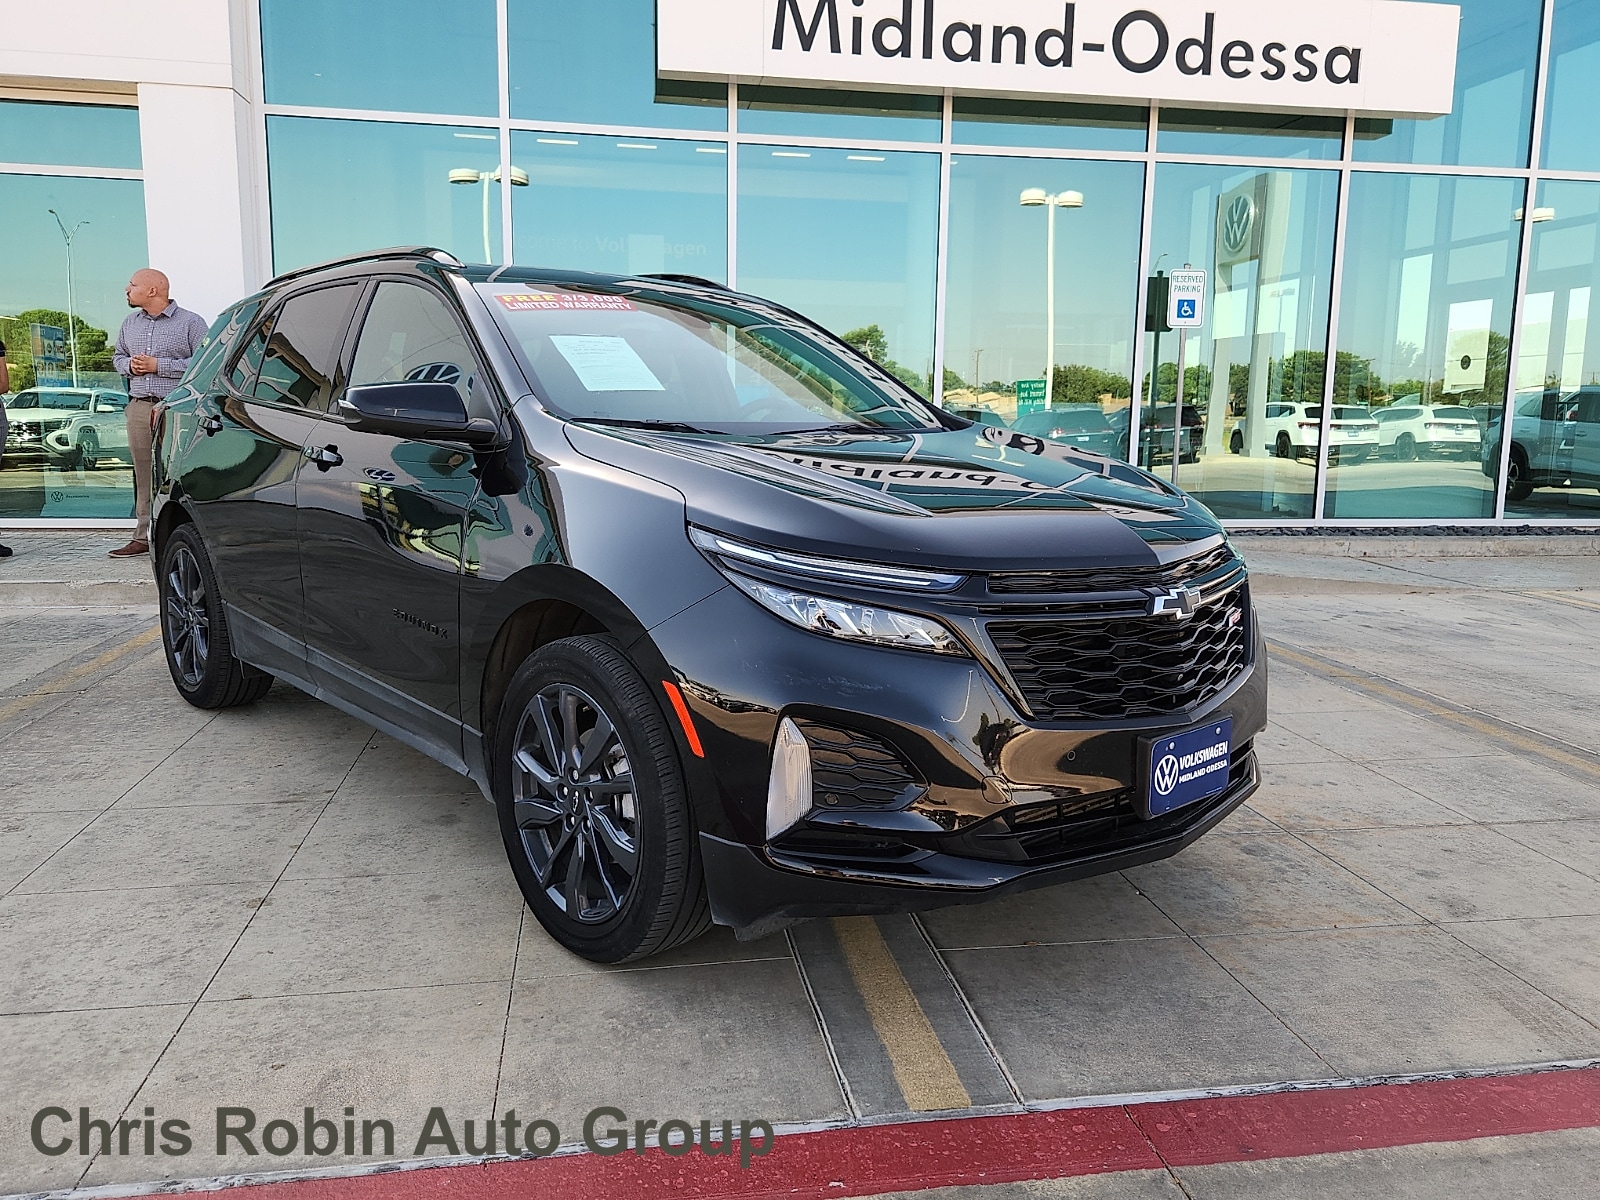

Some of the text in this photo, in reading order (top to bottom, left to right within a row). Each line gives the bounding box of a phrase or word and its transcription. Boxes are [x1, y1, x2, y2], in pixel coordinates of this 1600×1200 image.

[771, 0, 1361, 84] Midland-Odessa
[595, 236, 708, 258] Volagen
[1172, 275, 1204, 284] RESERVED
[1173, 285, 1201, 293] PARKING
[501, 294, 558, 302] FREE
[504, 301, 632, 310] LIMITED WARRANTY
[1180, 741, 1228, 770] VOLKSWAGEN
[1179, 759, 1228, 784] MIDLAND ODESSA
